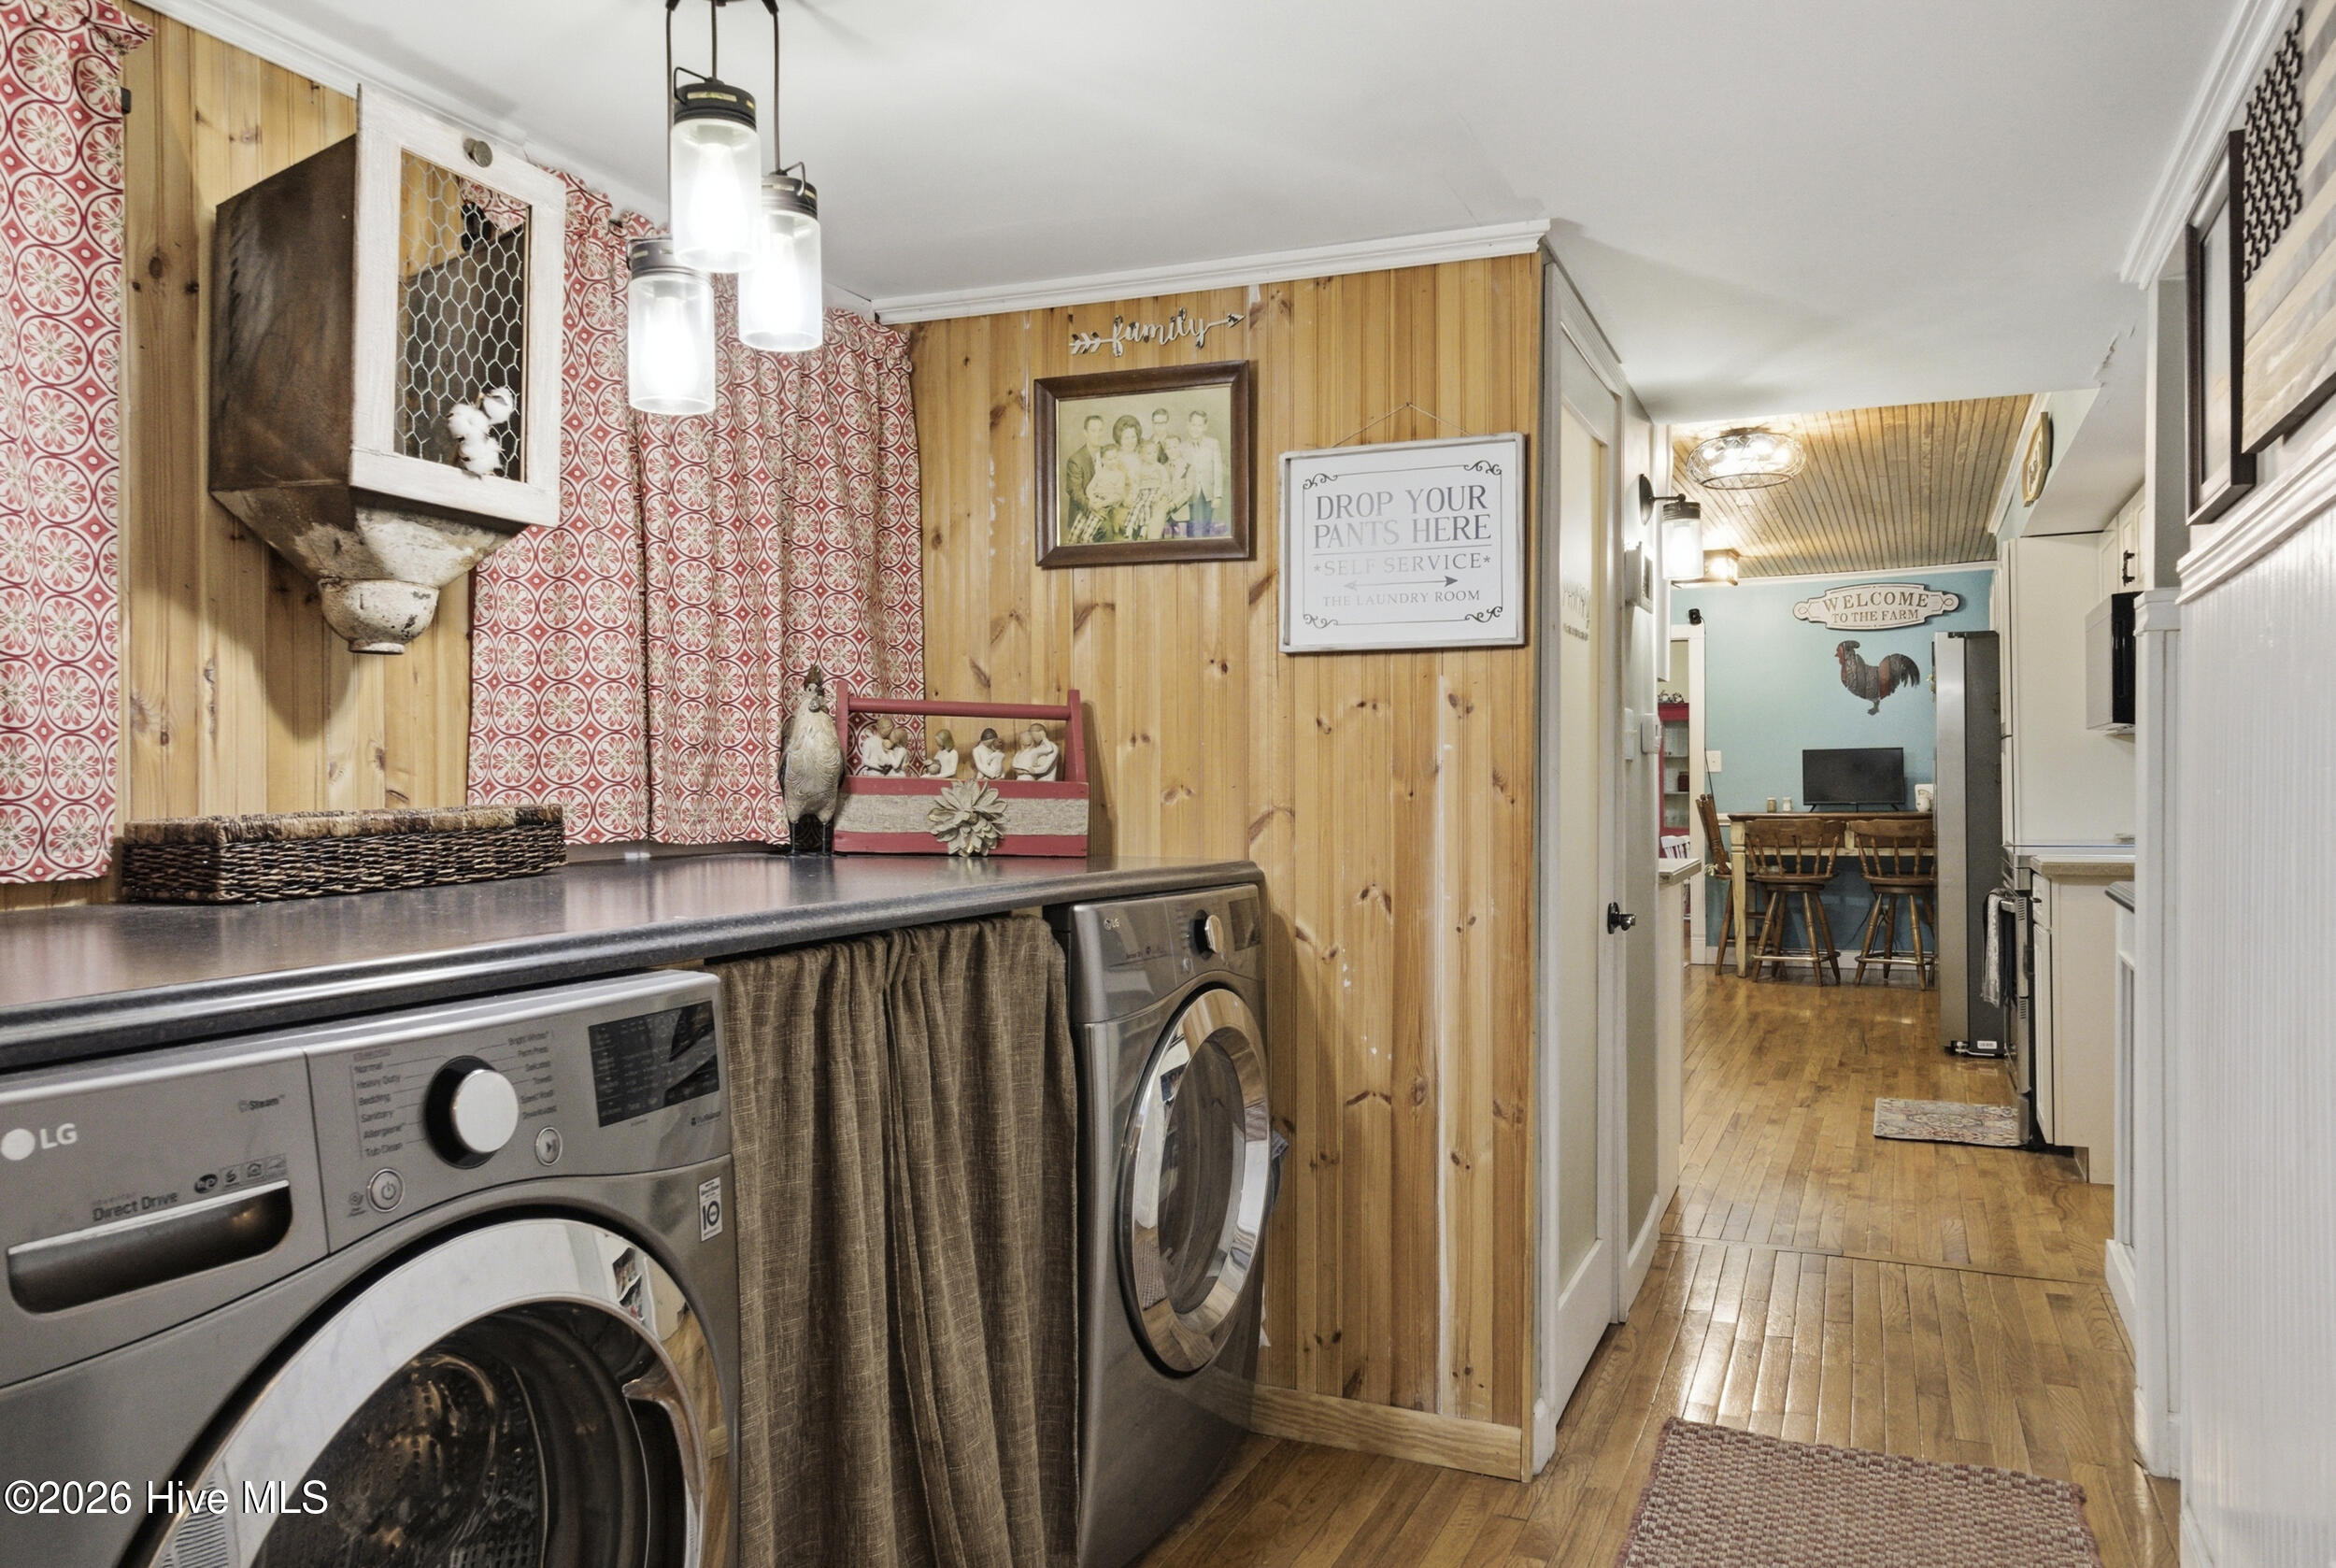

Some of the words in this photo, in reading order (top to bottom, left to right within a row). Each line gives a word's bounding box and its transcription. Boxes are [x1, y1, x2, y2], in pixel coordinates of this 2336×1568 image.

[1112, 307, 1204, 357] family
[1316, 491, 1393, 520] DROP
[1405, 484, 1488, 513] YOUR
[1314, 520, 1400, 549] PANTS
[1412, 514, 1491, 544] HERE
[1322, 594, 1351, 606] THE
[1357, 592, 1429, 606] LAUNDRY
[1434, 590, 1480, 603] ROOM
[1822, 592, 1930, 612] WELCOME
[1831, 613, 1848, 623] TO
[1851, 611, 1878, 621] THE
[1882, 609, 1919, 620] FARM
[39, 1123, 78, 1149] LG
[93, 1201, 138, 1221] Direct
[141, 1192, 178, 1210] Drive
